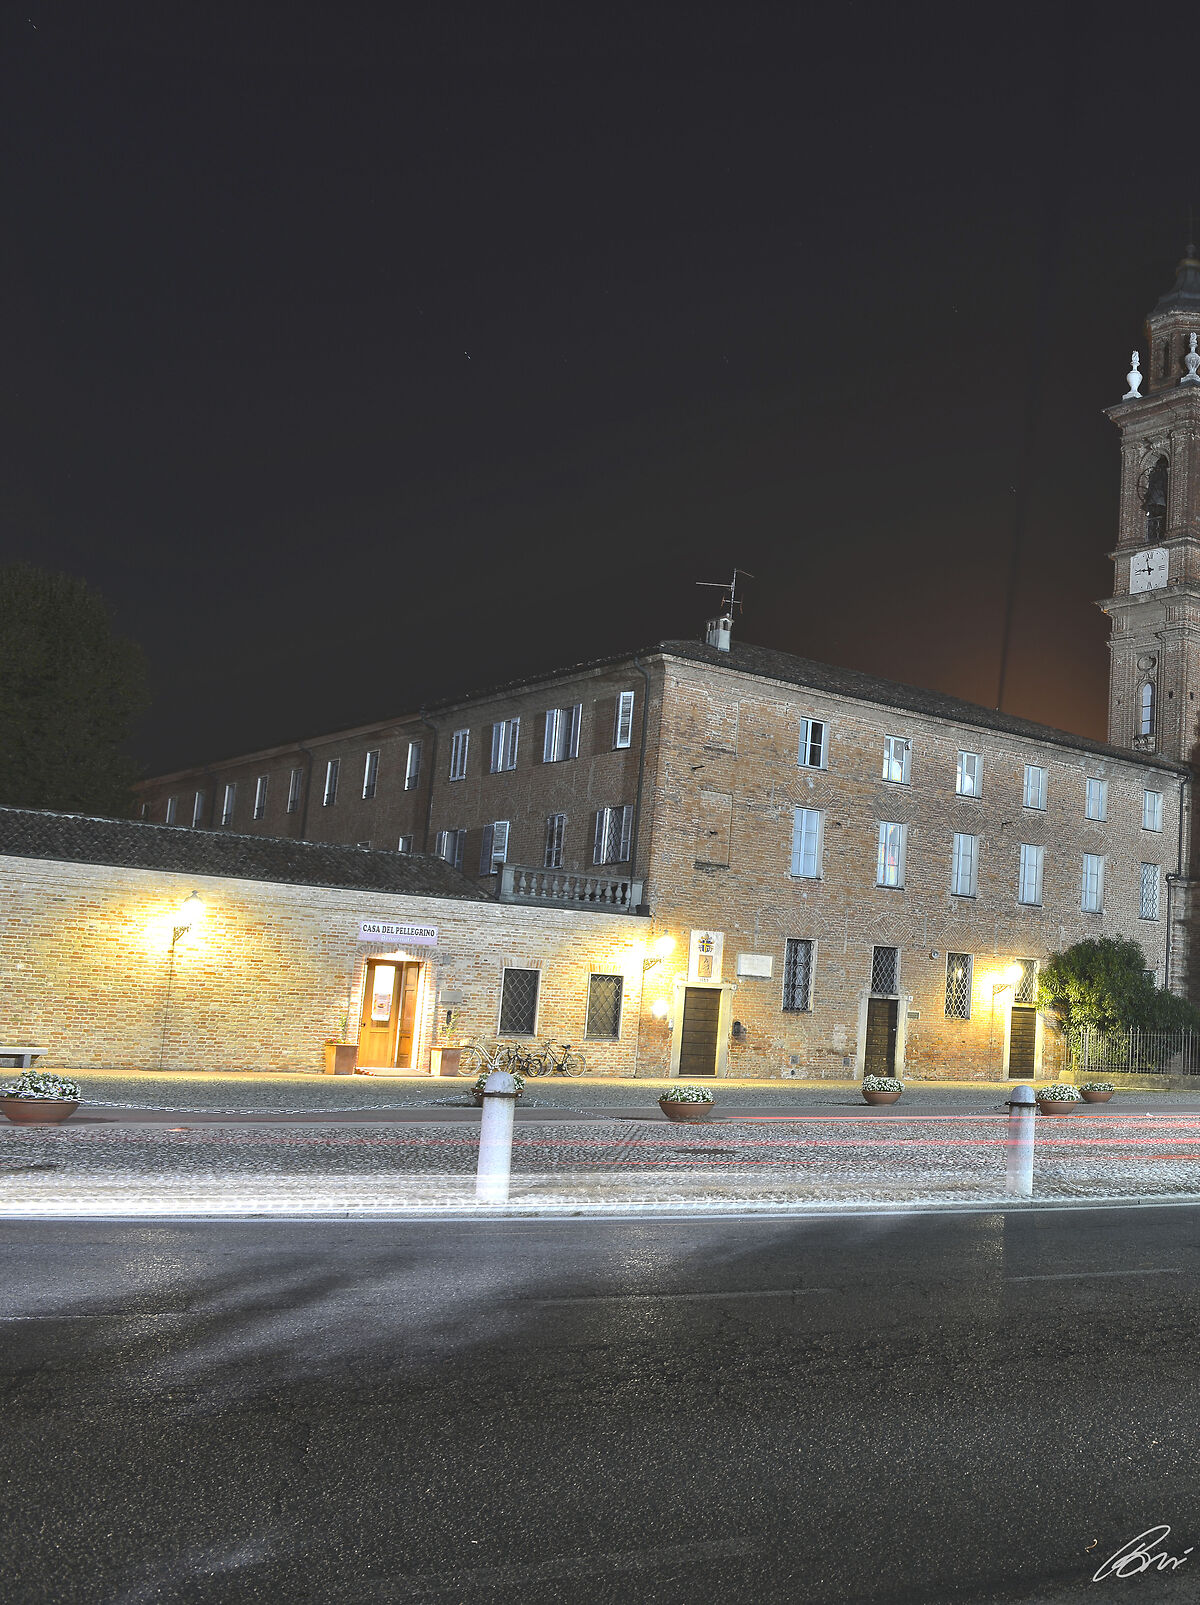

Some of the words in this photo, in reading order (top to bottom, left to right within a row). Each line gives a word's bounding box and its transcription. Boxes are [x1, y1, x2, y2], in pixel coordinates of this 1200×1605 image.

[362, 924, 380, 933] CASA
[382, 925, 394, 934] DEL
[395, 927, 435, 937] PELLEGRINO
